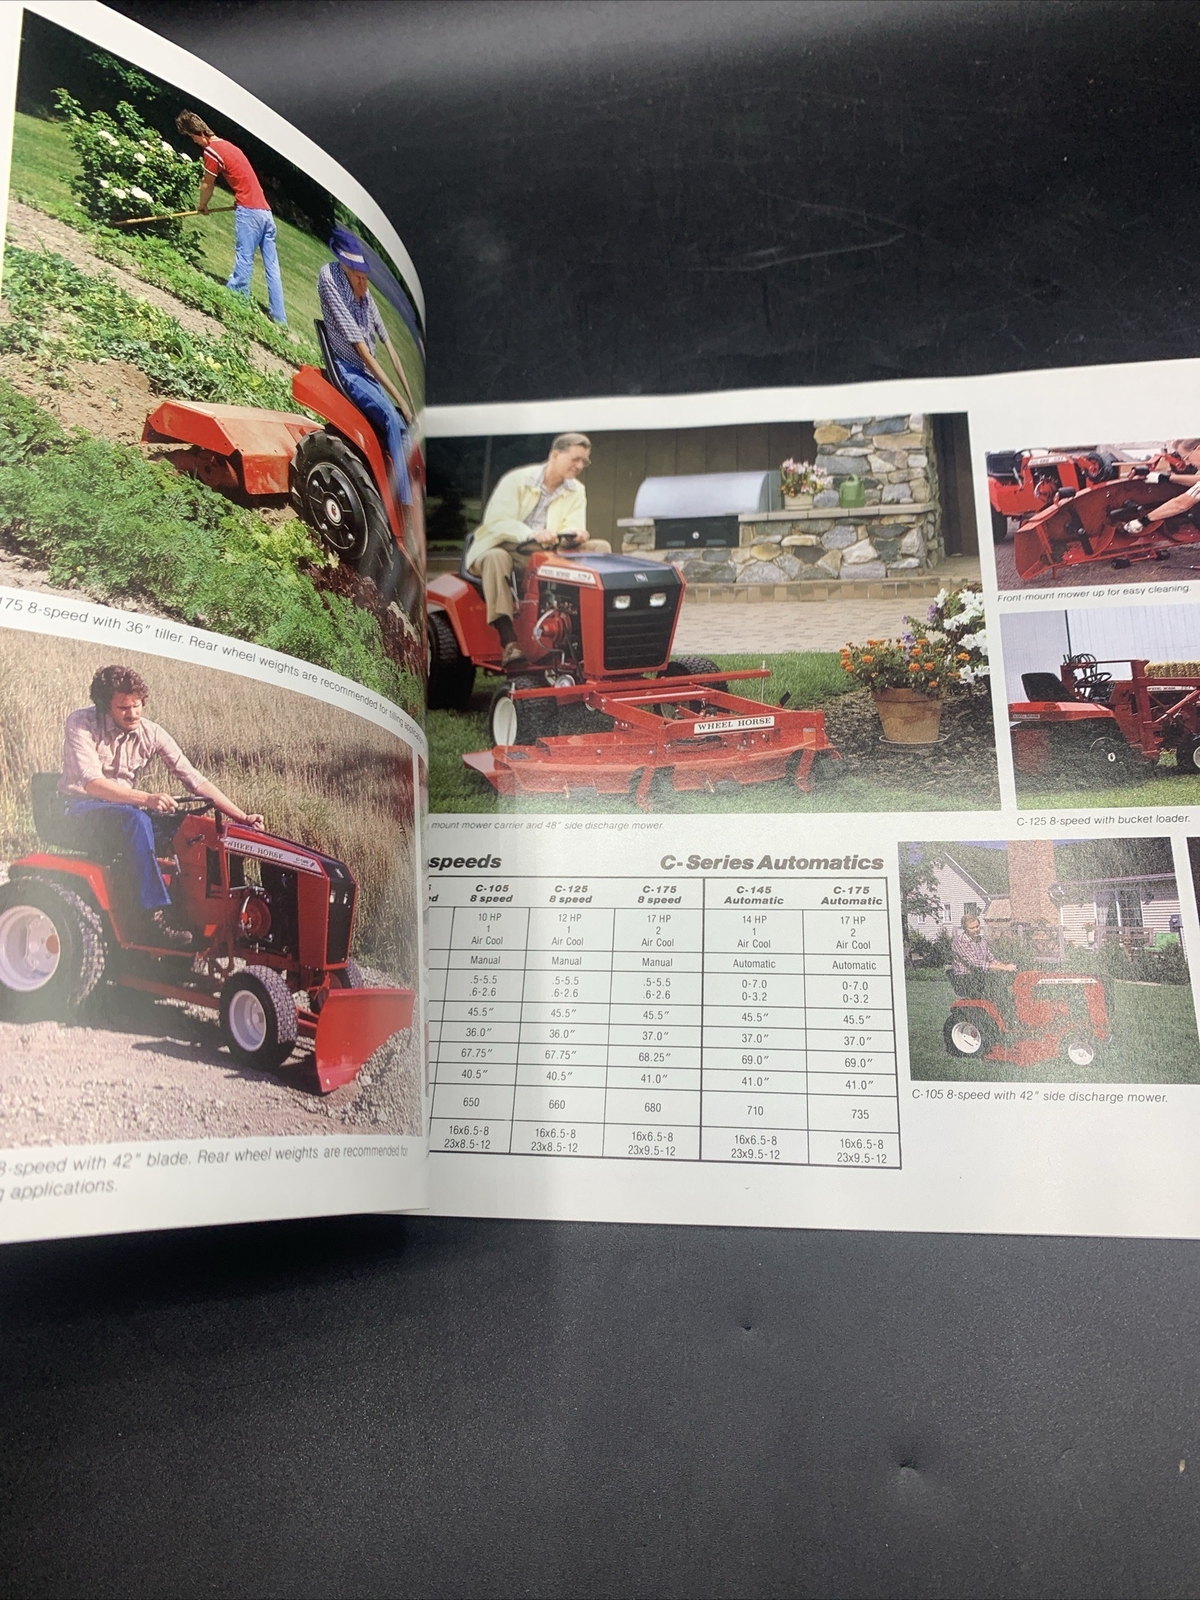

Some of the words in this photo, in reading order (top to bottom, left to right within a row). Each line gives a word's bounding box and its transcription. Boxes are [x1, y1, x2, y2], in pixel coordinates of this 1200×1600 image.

[998, 592, 1054, 602] Front-mount
[1092, 590, 1105, 598] up
[1108, 588, 1120, 596] for
[1123, 587, 1146, 595] easy
[1148, 585, 1192, 594] cleaning.
[28, 601, 90, 622] 8-speed
[93, 616, 122, 630] with
[126, 621, 150, 634] 36"
[155, 628, 184, 644] tiller.
[189, 636, 218, 652] Rear
[222, 647, 256, 662] wheel
[260, 656, 300, 676] weights
[302, 670, 318, 683] are
[319, 677, 379, 711] recommended
[379, 703, 388, 715] for
[698, 721, 733, 730] WHEEL
[738, 717, 771, 726] HORSE
[1016, 816, 1046, 826] C-125
[1050, 816, 1091, 826] 8-speed
[1094, 815, 1114, 824] with
[1118, 815, 1152, 824] bucket
[1156, 814, 1190, 823] loader.
[494, 821, 524, 829] carrier
[526, 821, 543, 829] and
[564, 821, 583, 829] side
[585, 821, 629, 831] discharge
[632, 822, 664, 830] mower.
[257, 847, 284, 860] HORSE
[429, 854, 502, 871] speeds
[756, 854, 884, 870] Automatics
[476, 884, 509, 893] C-105
[554, 885, 588, 893] C-125
[643, 886, 677, 894] C-175
[736, 886, 772, 894] C-145
[833, 886, 870, 894] C-175
[479, 895, 513, 904] speed
[559, 895, 592, 904] speed
[638, 896, 645, 904] 8
[647, 896, 681, 905] speed
[724, 896, 784, 904] Automatic
[821, 896, 882, 906] Automatic
[478, 913, 487, 921] 10
[490, 913, 502, 922] HP
[558, 914, 567, 922] 12
[570, 914, 582, 922] HP
[647, 914, 656, 922] 17
[659, 914, 671, 923] HP
[742, 916, 752, 924] 14
[755, 915, 767, 924] HP
[840, 916, 850, 924] 17
[853, 916, 866, 924] HP
[471, 936, 483, 944] Air
[486, 936, 503, 945] Cool
[551, 937, 563, 945] Air
[566, 937, 584, 946] Cool
[641, 938, 653, 946] Air
[656, 938, 674, 947] Cool
[737, 939, 749, 948] Air
[753, 939, 771, 948] Cool
[836, 940, 848, 949] Air
[852, 940, 870, 950] Cool
[470, 956, 500, 964] Manual
[552, 957, 582, 966] Manual
[642, 958, 672, 967] Manual
[732, 959, 776, 968] Automatic
[832, 961, 876, 970] Automatic
[470, 975, 498, 984] .5-5.5
[552, 976, 579, 985] .5-5.5
[643, 978, 671, 987] .5-5.5
[742, 979, 767, 988] 0-7.0
[842, 981, 868, 990] 0-7.0
[468, 987, 496, 996] .6-2.6
[551, 988, 578, 998] .6-2.6
[643, 990, 670, 1000] .6-2.6
[742, 992, 767, 1002] 0-3.2
[842, 994, 868, 1003] 0-3.2
[468, 1007, 494, 1016] 45.5"
[550, 1008, 576, 1018] 45.5"
[643, 1010, 669, 1020] 45.5"
[742, 1012, 768, 1022] 45.5"
[843, 1015, 870, 1025] 45.5"
[466, 1028, 492, 1037] 36.0"
[549, 1029, 575, 1038] 36.0"
[642, 1031, 669, 1041] 37.0"
[742, 1033, 768, 1043] 37.0"
[844, 1036, 872, 1046] 37.0"
[461, 1048, 492, 1058] 67.75"
[545, 1050, 576, 1060] 67.75"
[638, 1052, 670, 1062] 68.25"
[742, 1055, 769, 1065] 69.0"
[844, 1058, 873, 1068] 69.0"
[462, 1069, 488, 1079] 40.5"
[546, 1071, 572, 1081] 40.5"
[641, 1074, 667, 1084] 41.0"
[742, 1077, 769, 1086] 41.0"
[846, 1080, 873, 1090] 41.0"
[912, 1089, 944, 1099] C-105
[947, 1089, 990, 1101] 8-speed
[994, 1090, 1016, 1100] with
[1020, 1090, 1040, 1100] 42"
[1043, 1090, 1065, 1101] side
[1069, 1091, 1123, 1104] discharge
[1128, 1094, 1168, 1102] mower.
[463, 1097, 480, 1107] 650
[549, 1100, 565, 1110] 660
[644, 1102, 662, 1112] 680
[747, 1106, 764, 1116] 710
[852, 1109, 869, 1120] 735
[449, 1125, 489, 1135] 16x6.5-8
[536, 1128, 576, 1139] 16x6.5-8
[632, 1131, 674, 1142] 16x6.5-8
[734, 1135, 777, 1146] 16x6.5-8
[444, 1140, 490, 1149] 23x8.5-12
[531, 1142, 578, 1152] 23x8.5-12
[840, 1138, 884, 1150] 16x6.5-8
[628, 1146, 676, 1156] 23x9.5-12
[731, 1149, 780, 1160] 23x9.5-12
[73, 1156, 106, 1171] with
[112, 1152, 142, 1169] 42"
[147, 1151, 191, 1167] blade.
[198, 1149, 230, 1164] Rear
[234, 1147, 272, 1162] wheel
[275, 1147, 318, 1163] weights
[324, 1147, 340, 1158] are
[343, 1145, 399, 1157] recommended
[837, 1153, 887, 1164] 23x9.5-12
[10, 1179, 118, 1201] applications.
